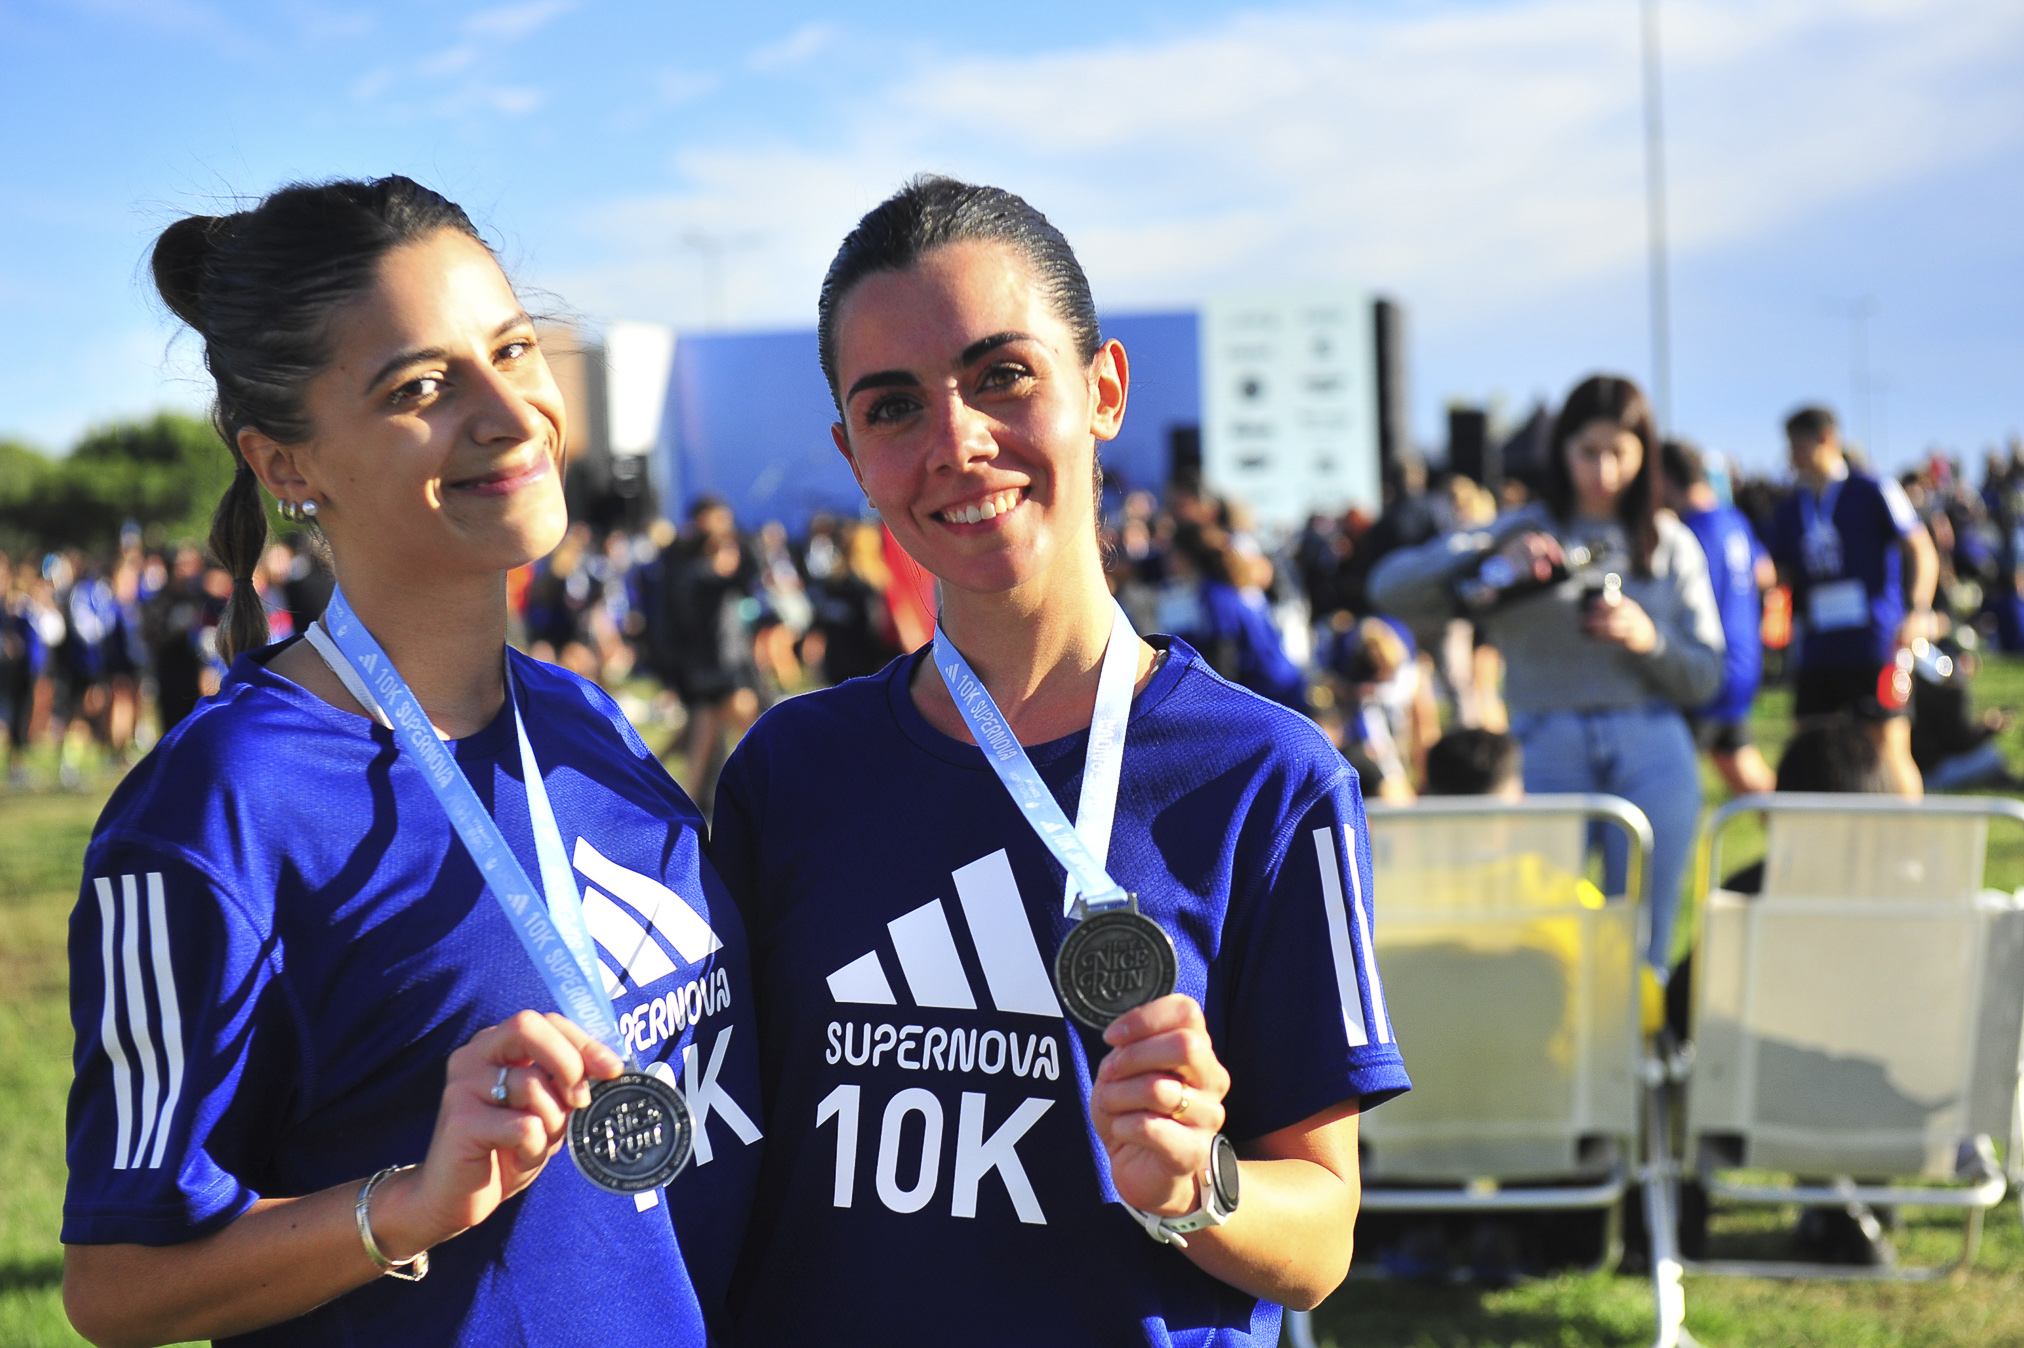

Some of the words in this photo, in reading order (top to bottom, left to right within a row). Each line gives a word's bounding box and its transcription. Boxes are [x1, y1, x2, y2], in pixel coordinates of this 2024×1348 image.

[375, 668, 403, 706] 10K
[395, 701, 455, 788] SUPERNOVA
[957, 674, 981, 706] 10K
[970, 700, 1018, 761] SUPERNOVA
[524, 911, 557, 951] 10K
[545, 948, 612, 1042] SUPERNOVA
[1079, 969, 1145, 1001] RUN
[1081, 948, 1149, 971] NICE
[620, 967, 731, 1055] PERNOVA
[825, 1020, 1060, 1081] SUPERNOVA
[815, 1084, 1056, 1225] 10K
